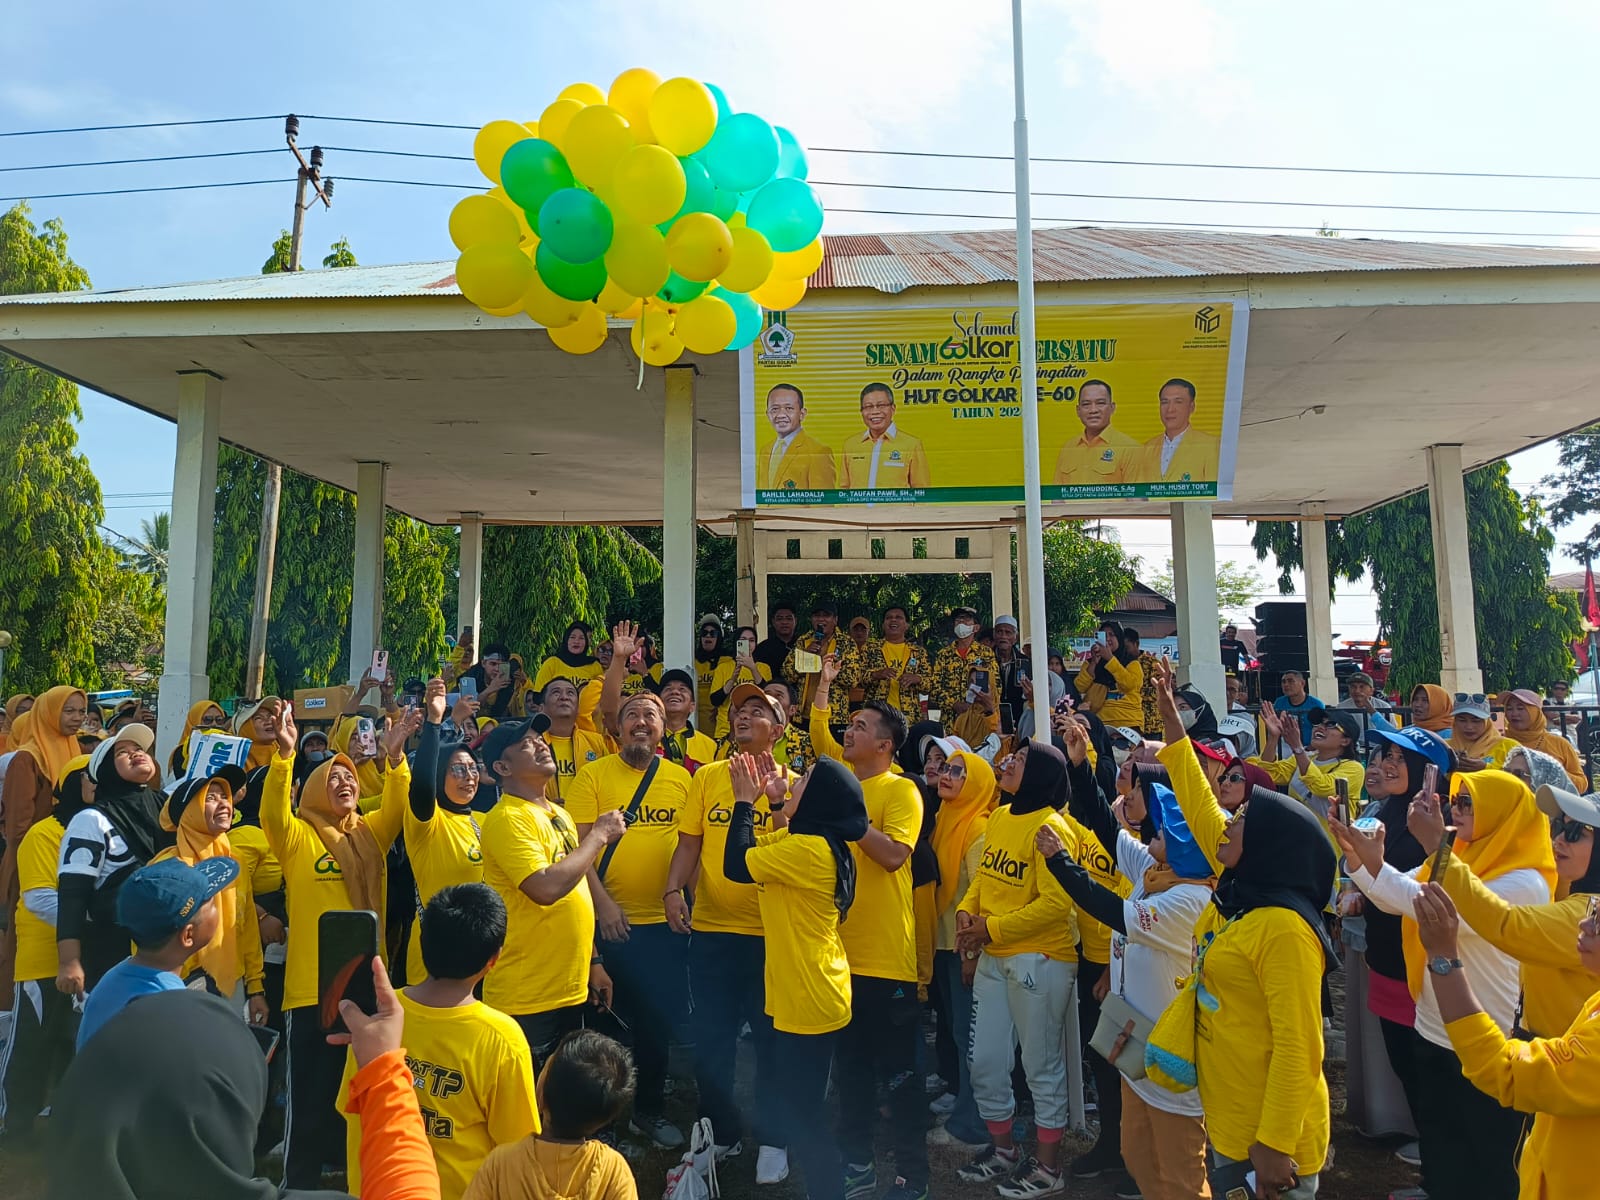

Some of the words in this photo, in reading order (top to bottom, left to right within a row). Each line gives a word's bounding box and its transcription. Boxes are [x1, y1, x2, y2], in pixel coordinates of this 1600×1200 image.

[865, 342, 938, 366] SENAM
[1017, 338, 1117, 363] ERSATU
[892, 367, 943, 389] Dalam
[947, 366, 1005, 387] Rangka
[1009, 364, 1088, 384] Pingatan
[903, 389, 941, 404] HUT
[943, 387, 1018, 403] GOLKAR
[1020, 386, 1076, 402] E-60
[952, 407, 995, 418] TAHUN
[999, 405, 1022, 418] 202
[1162, 645, 1171, 655] 2
[429, 1065, 465, 1099] TP
